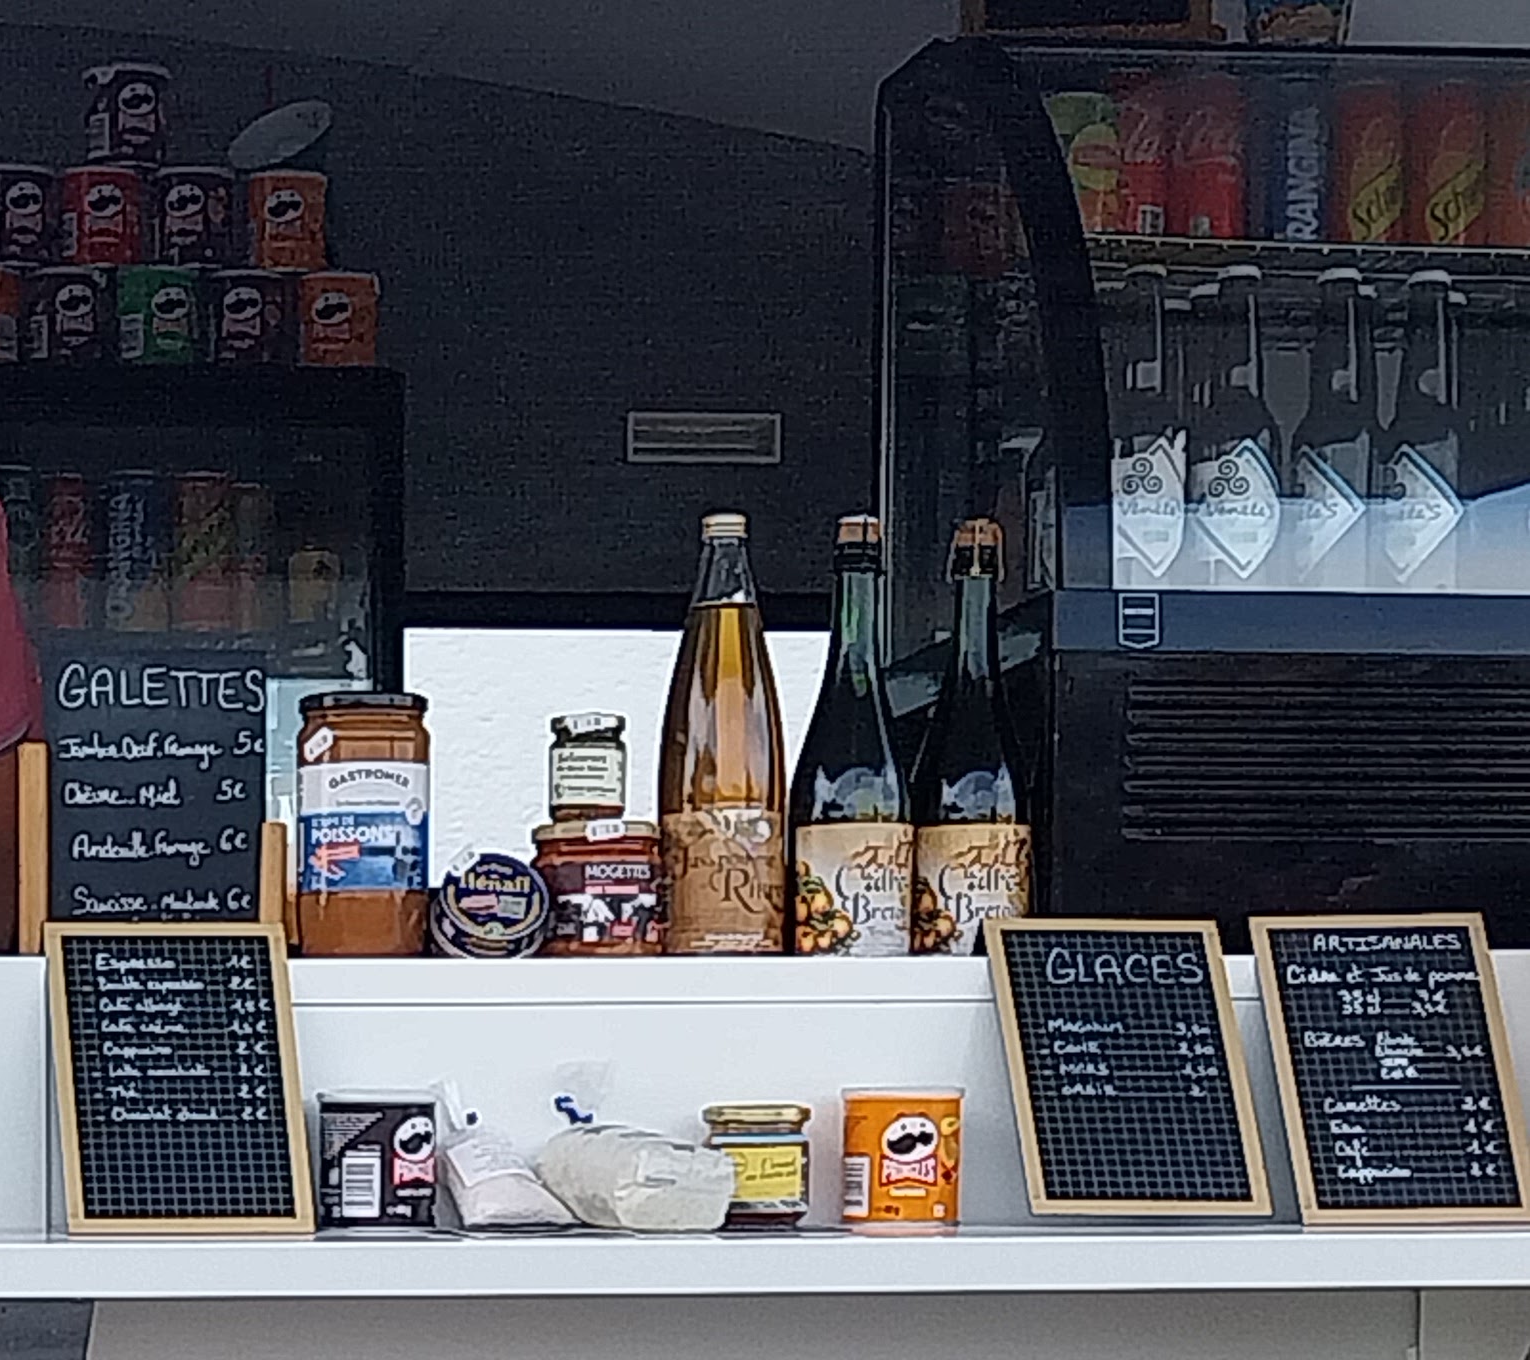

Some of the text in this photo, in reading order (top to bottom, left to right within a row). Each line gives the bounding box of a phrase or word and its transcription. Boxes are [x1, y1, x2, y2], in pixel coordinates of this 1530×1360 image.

[1284, 105, 1321, 242] RANGINA
[58, 662, 266, 714] GALETTES
[1045, 946, 1204, 985] GLACES
[1312, 933, 1463, 953] ARTISANALES
